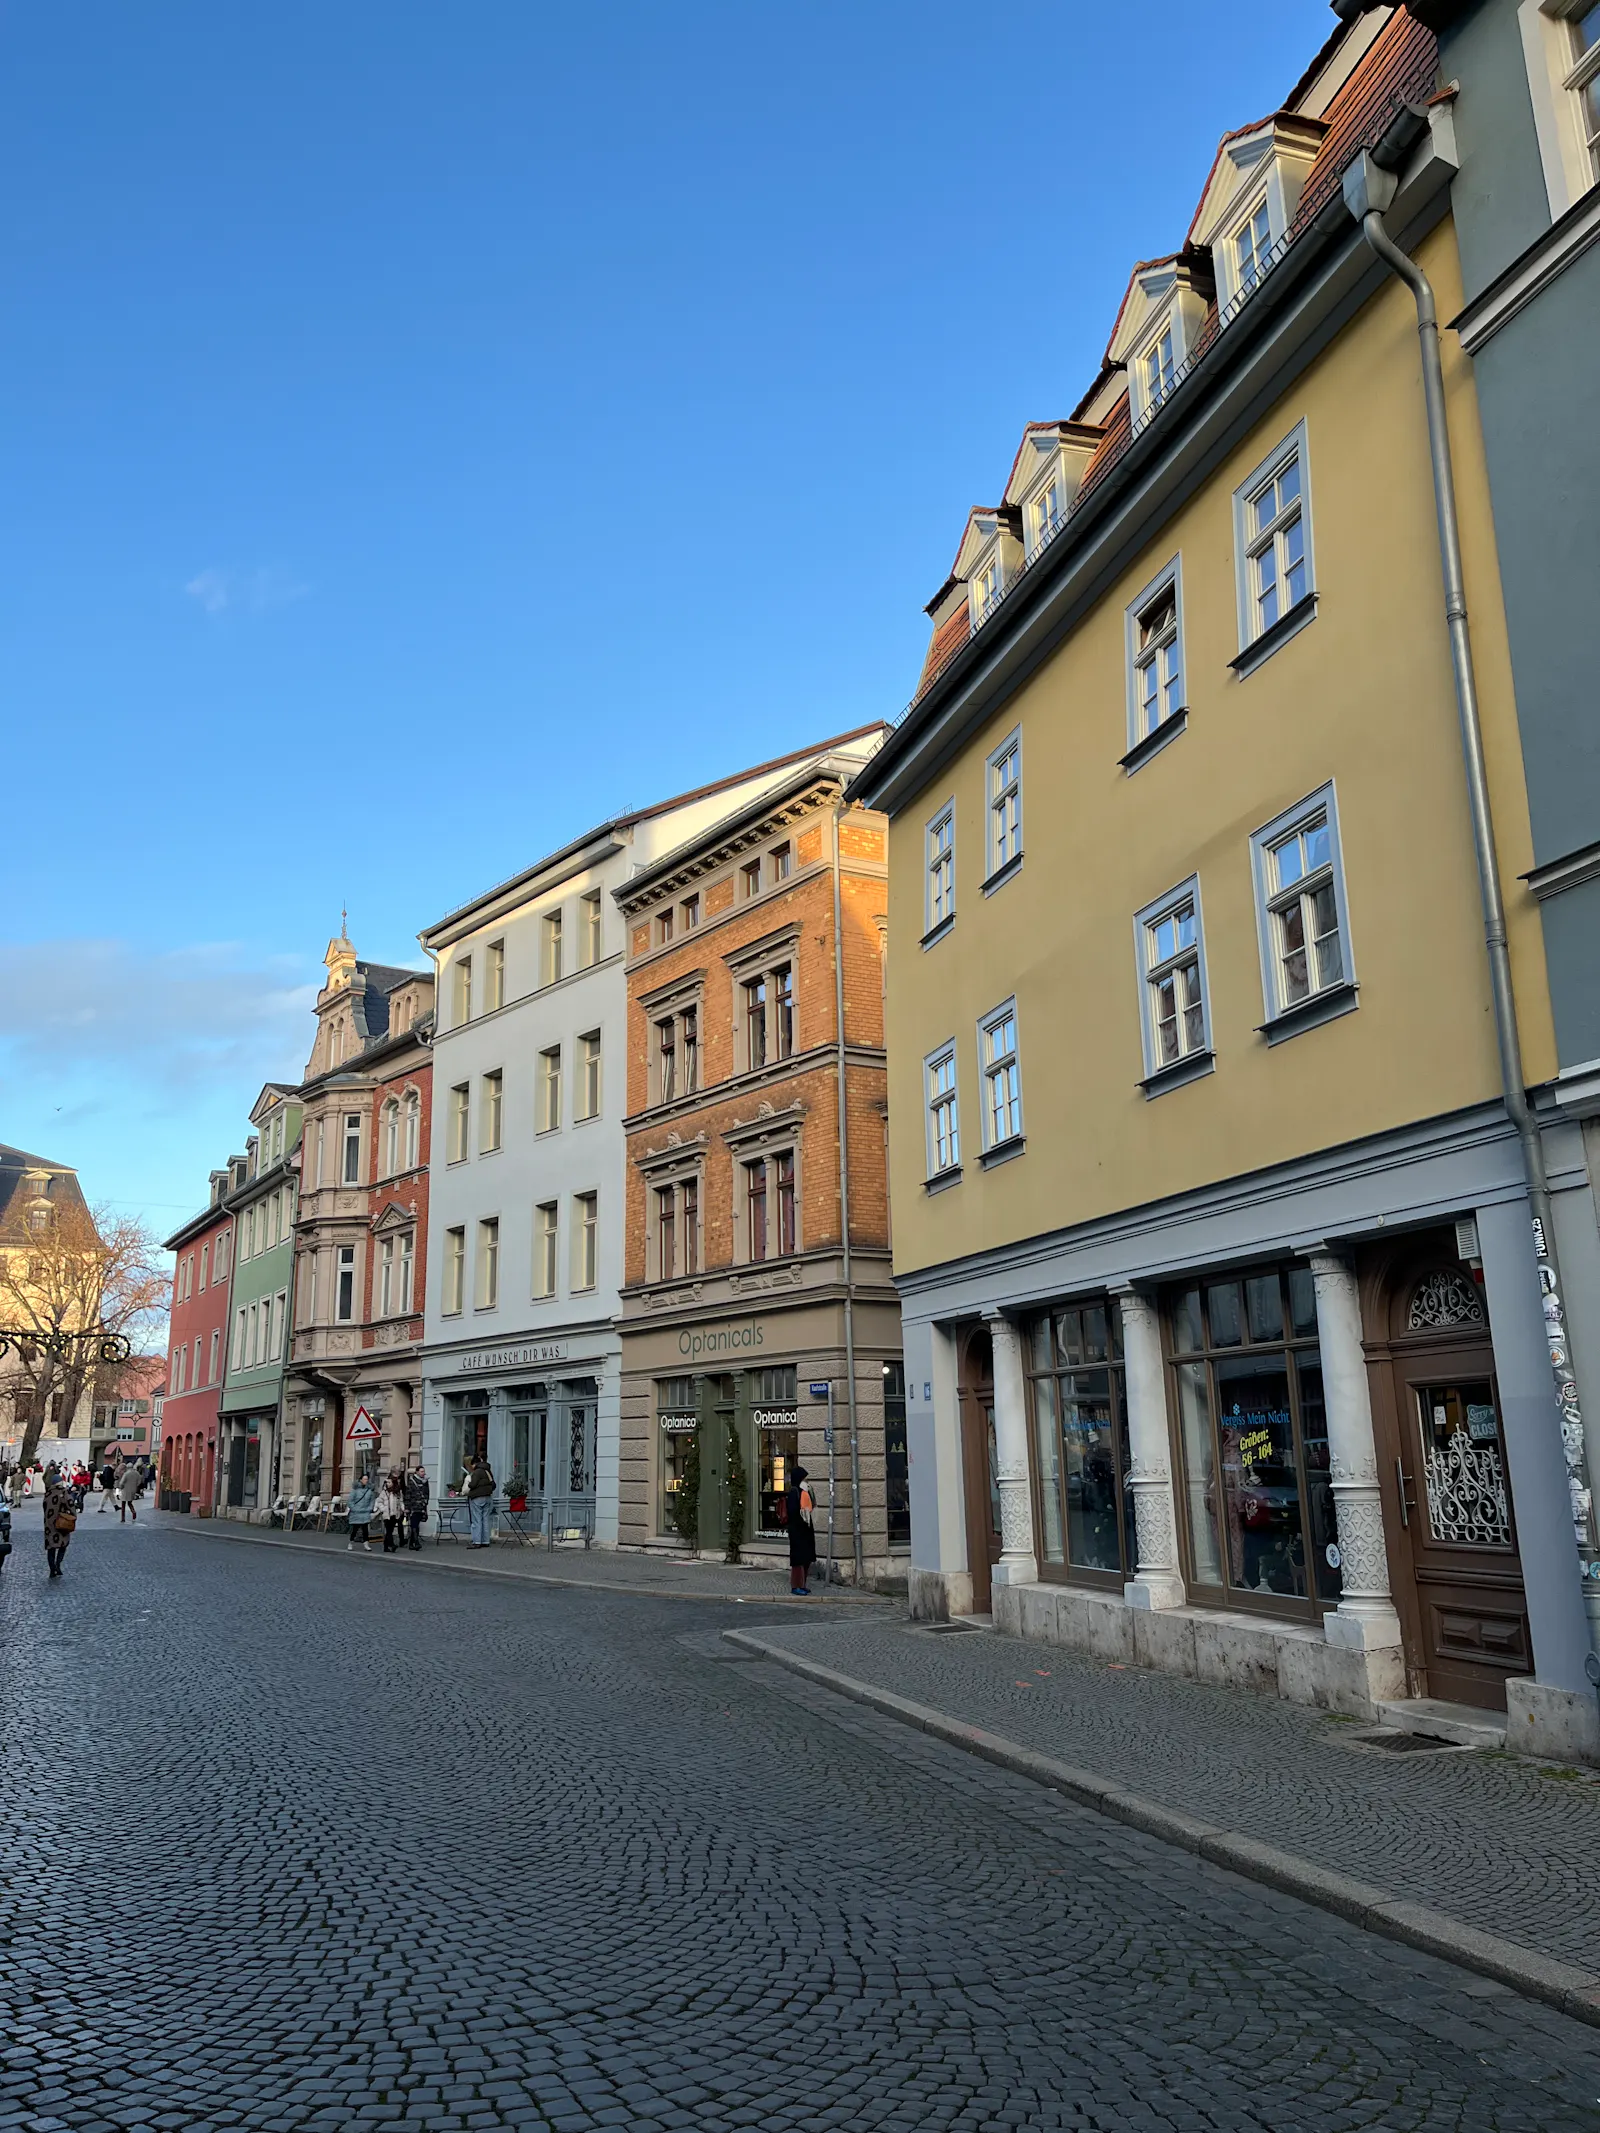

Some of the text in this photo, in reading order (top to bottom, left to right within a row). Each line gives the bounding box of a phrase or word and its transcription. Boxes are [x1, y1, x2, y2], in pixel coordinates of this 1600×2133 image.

[1532, 1218, 1547, 1257] FUNK25
[678, 1318, 763, 1360] Optanicals
[462, 1353, 482, 1369] CAFÉ
[523, 1348, 538, 1362] DIR
[541, 1345, 560, 1359] WAS
[1220, 1409, 1290, 1430] Vergiss Mein Nicht
[1240, 1429, 1269, 1452] Größen:
[1242, 1450, 1253, 1468] 56
[1258, 1442, 1273, 1460] 164
